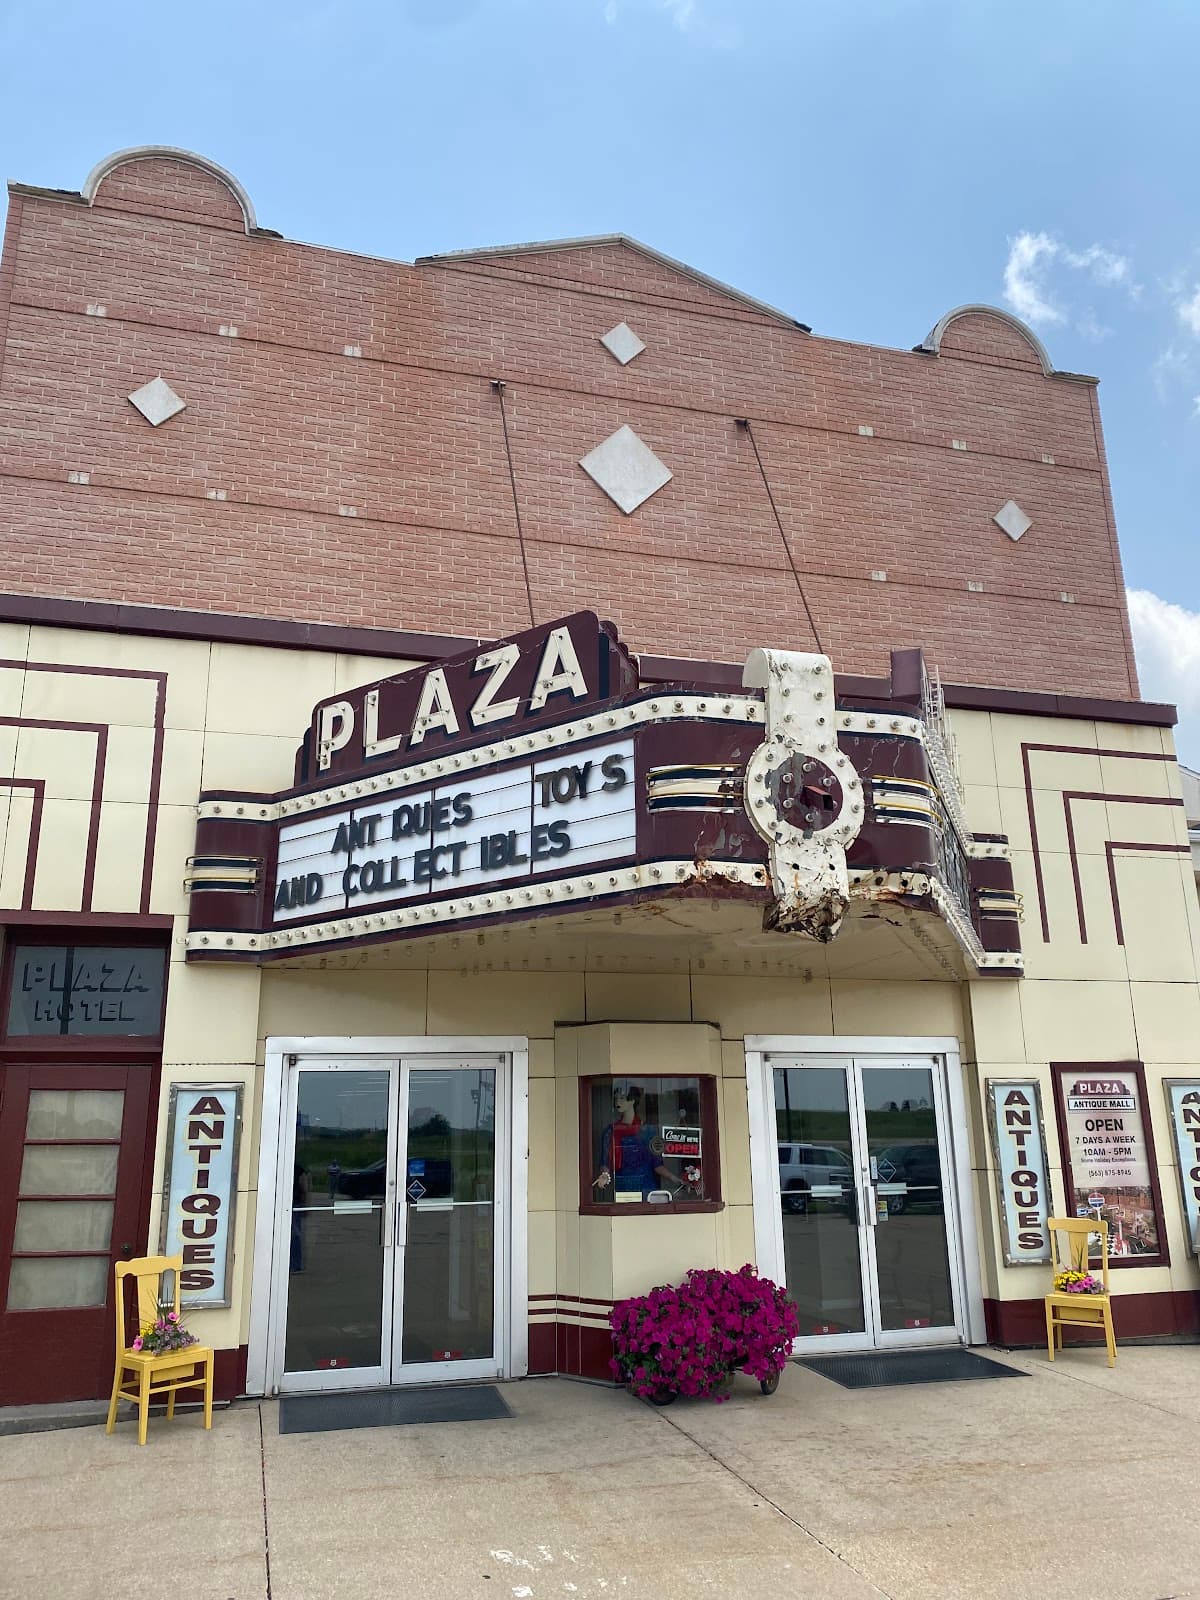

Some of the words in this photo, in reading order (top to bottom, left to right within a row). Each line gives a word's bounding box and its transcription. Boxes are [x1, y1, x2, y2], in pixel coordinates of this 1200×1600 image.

[317, 626, 588, 771] PLAZA
[274, 873, 324, 911] AND
[22, 961, 149, 992] PLAZA
[34, 1000, 136, 1021] HOTEL
[1079, 1083, 1121, 1094] PLAZA
[1073, 1100, 1108, 1108] ANTIQUE
[1109, 1100, 1131, 1108] MALL
[1085, 1118, 1124, 1132] OPEN
[1075, 1136, 1080, 1144] 7
[1082, 1136, 1104, 1144] DAYS
[1105, 1136, 1112, 1144] A
[1112, 1135, 1136, 1144] WEEK
[666, 1144, 698, 1154] OPEN
[1083, 1148, 1106, 1156] 10AM
[1113, 1147, 1132, 1155] 5PM
[1004, 1090, 1044, 1250] ANTIQUES
[180, 1096, 226, 1290] ANTIQUES
